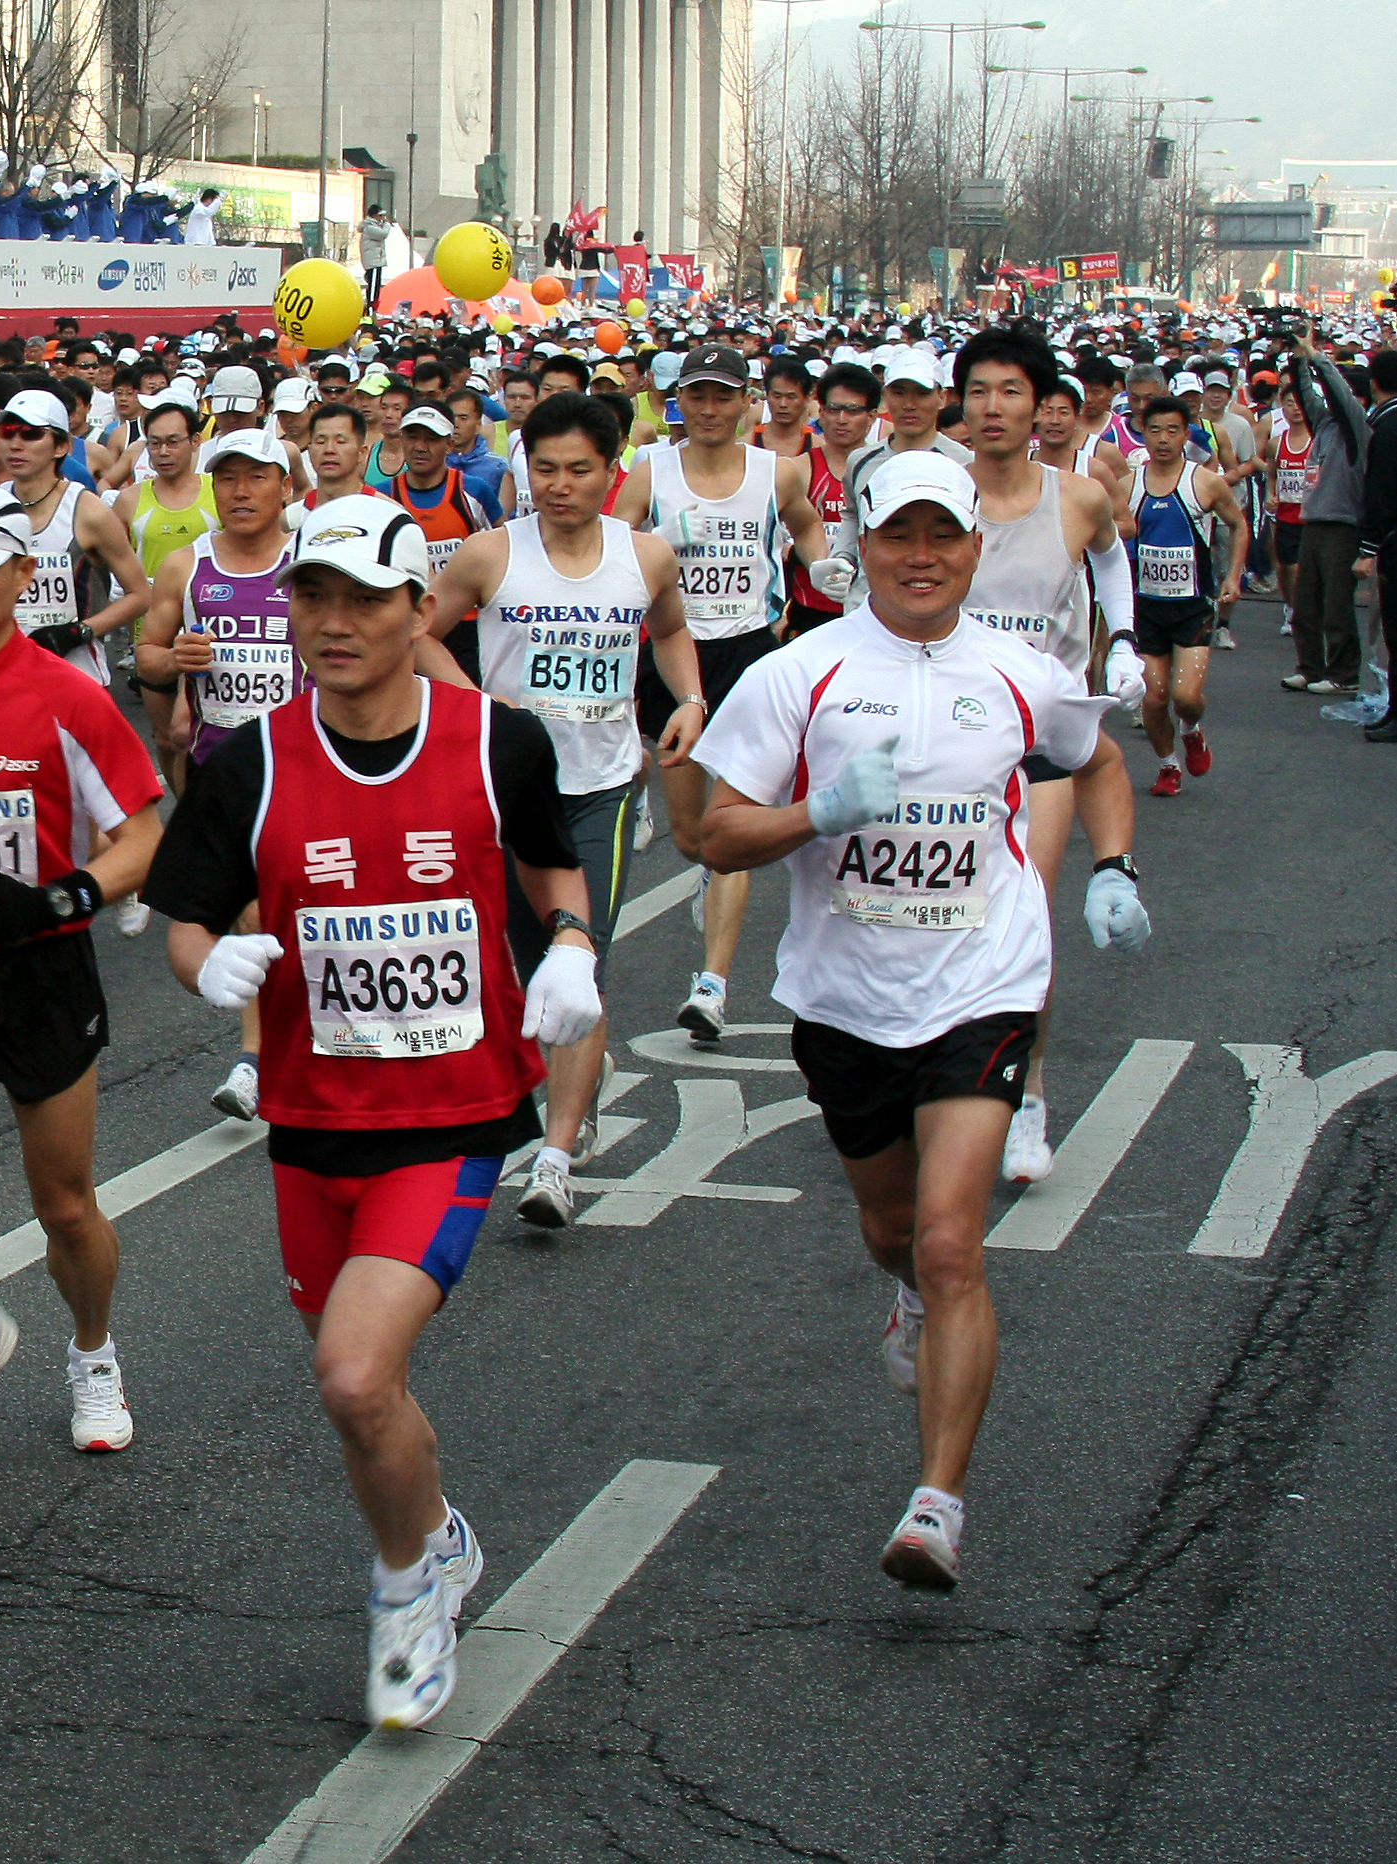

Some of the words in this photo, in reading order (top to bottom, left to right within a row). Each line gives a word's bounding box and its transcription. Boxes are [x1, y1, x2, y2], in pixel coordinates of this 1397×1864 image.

[1139, 546, 1192, 559] SAMSUNG
[676, 567, 751, 595] A2875
[1143, 562, 1190, 582] A3053
[203, 616, 289, 641] KD그룹
[499, 605, 601, 624] KOREAN
[605, 606, 644, 624] AIR
[530, 627, 633, 650] SAMSUNG
[205, 671, 285, 704] A3953
[530, 655, 622, 694] B5181
[836, 835, 977, 889] A2424
[303, 907, 473, 942] SAMSUNG
[903, 903, 966, 926] 서울특별시
[319, 950, 470, 1014] A3633
[392, 1025, 462, 1053] 서울특별시
